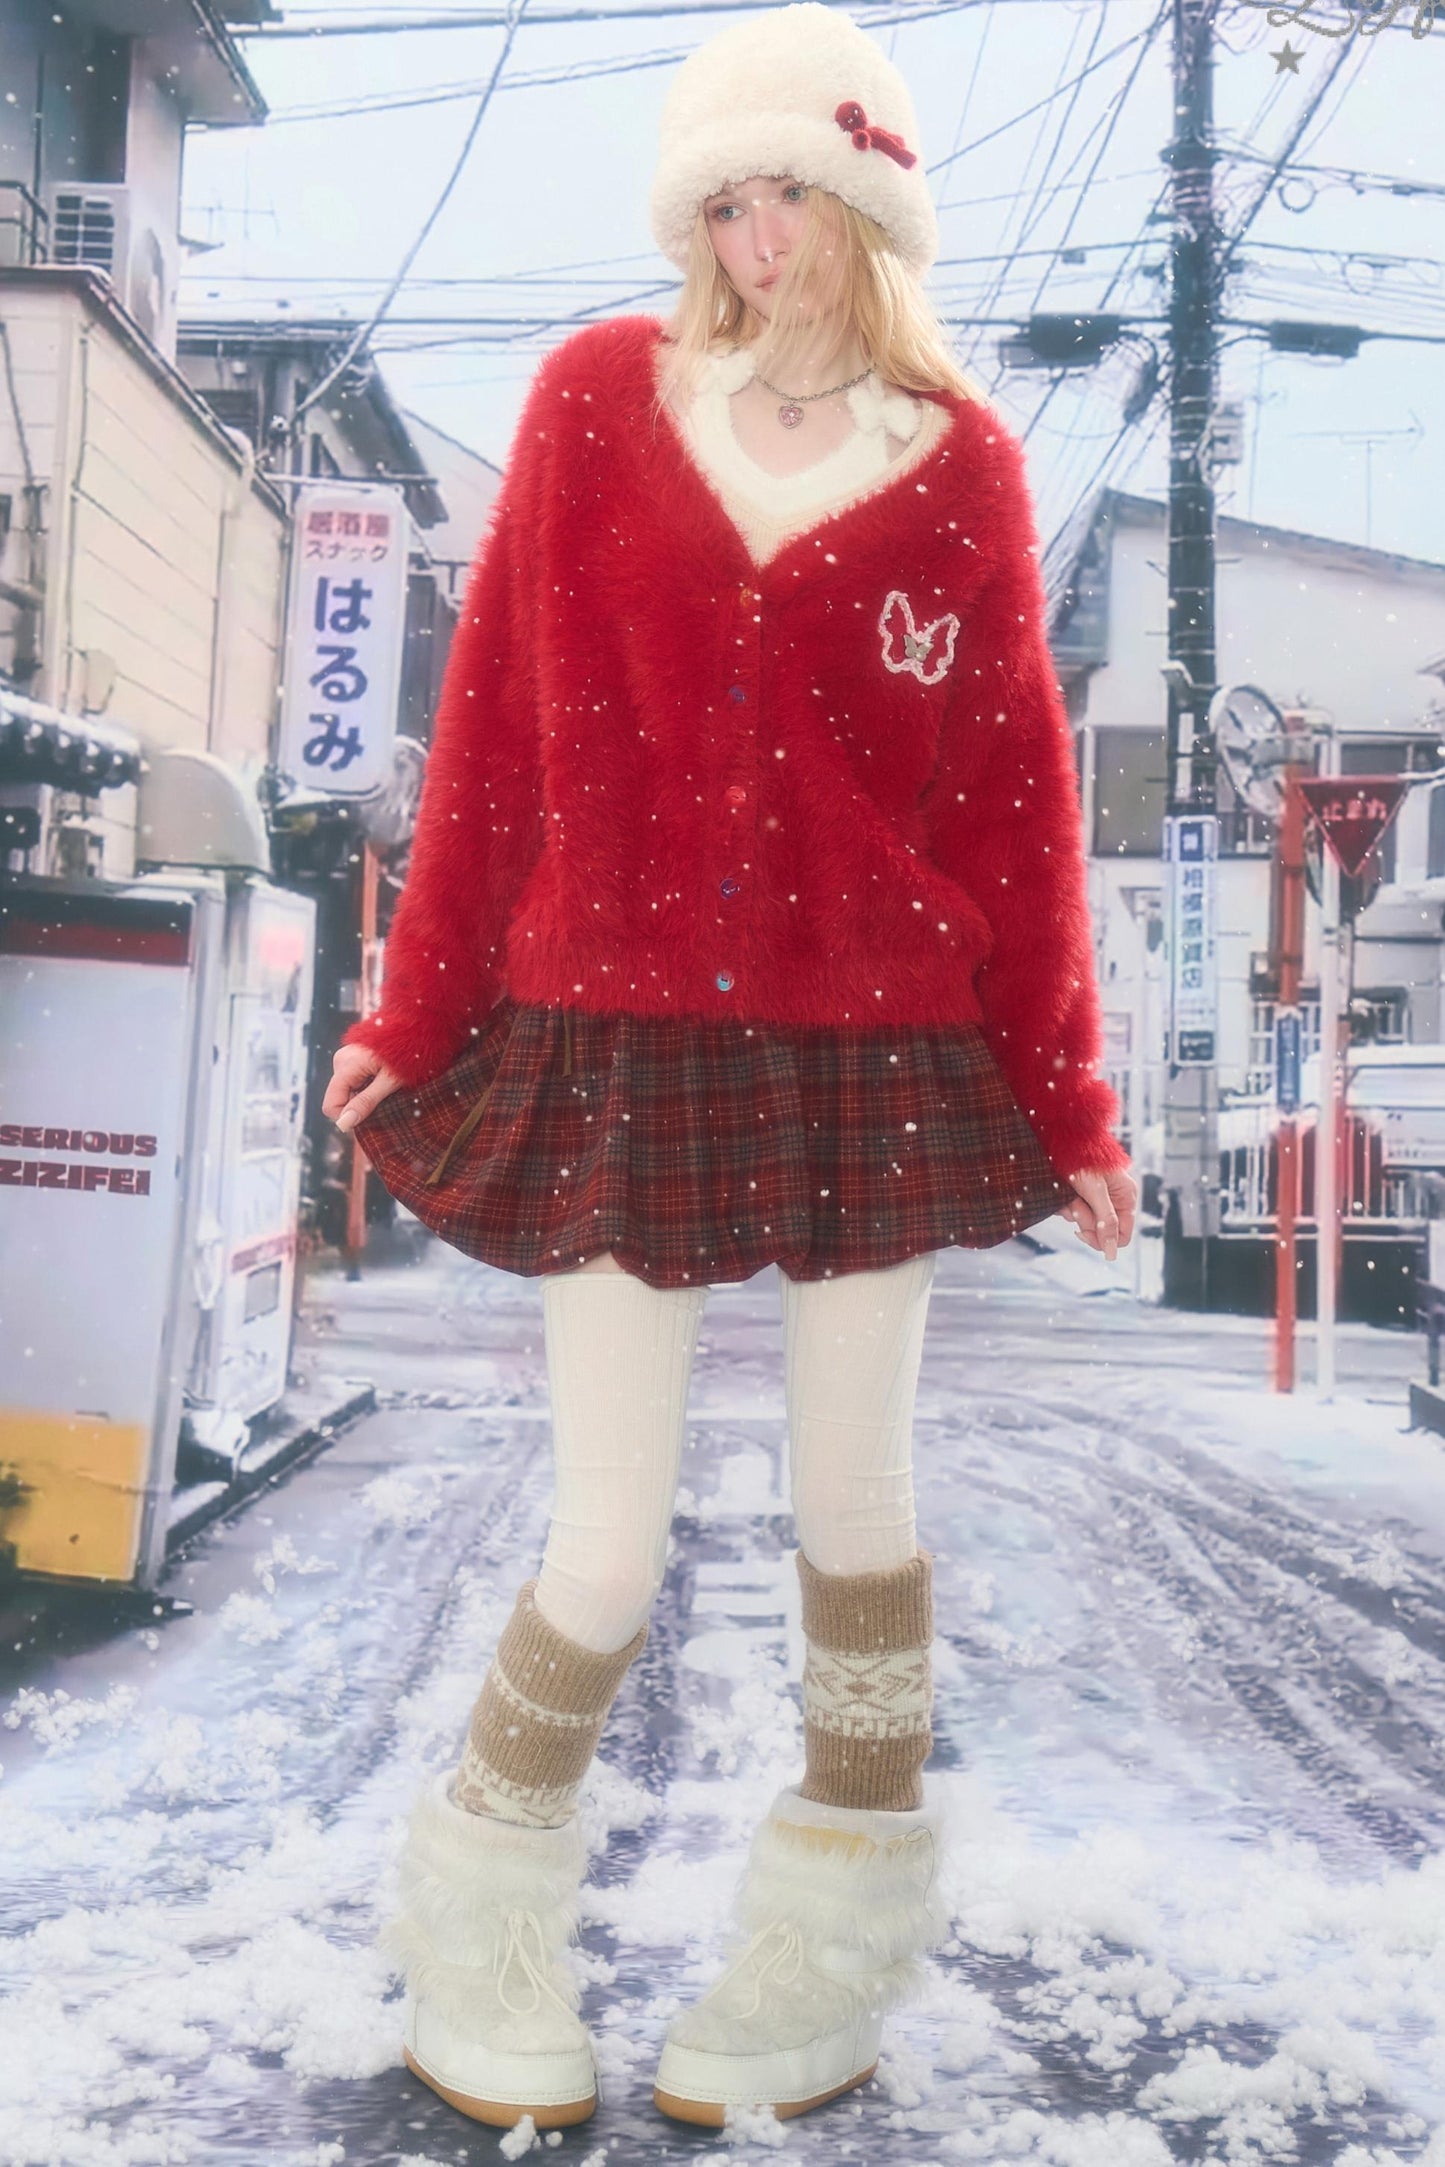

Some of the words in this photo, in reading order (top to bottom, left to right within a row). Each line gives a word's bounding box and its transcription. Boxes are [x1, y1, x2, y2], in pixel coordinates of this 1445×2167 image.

[306, 540, 388, 562] スナック
[303, 576, 373, 772] はるみ
[0, 1124, 158, 1157] SERIOUS
[0, 1158, 151, 1196] ZIZIFEI
